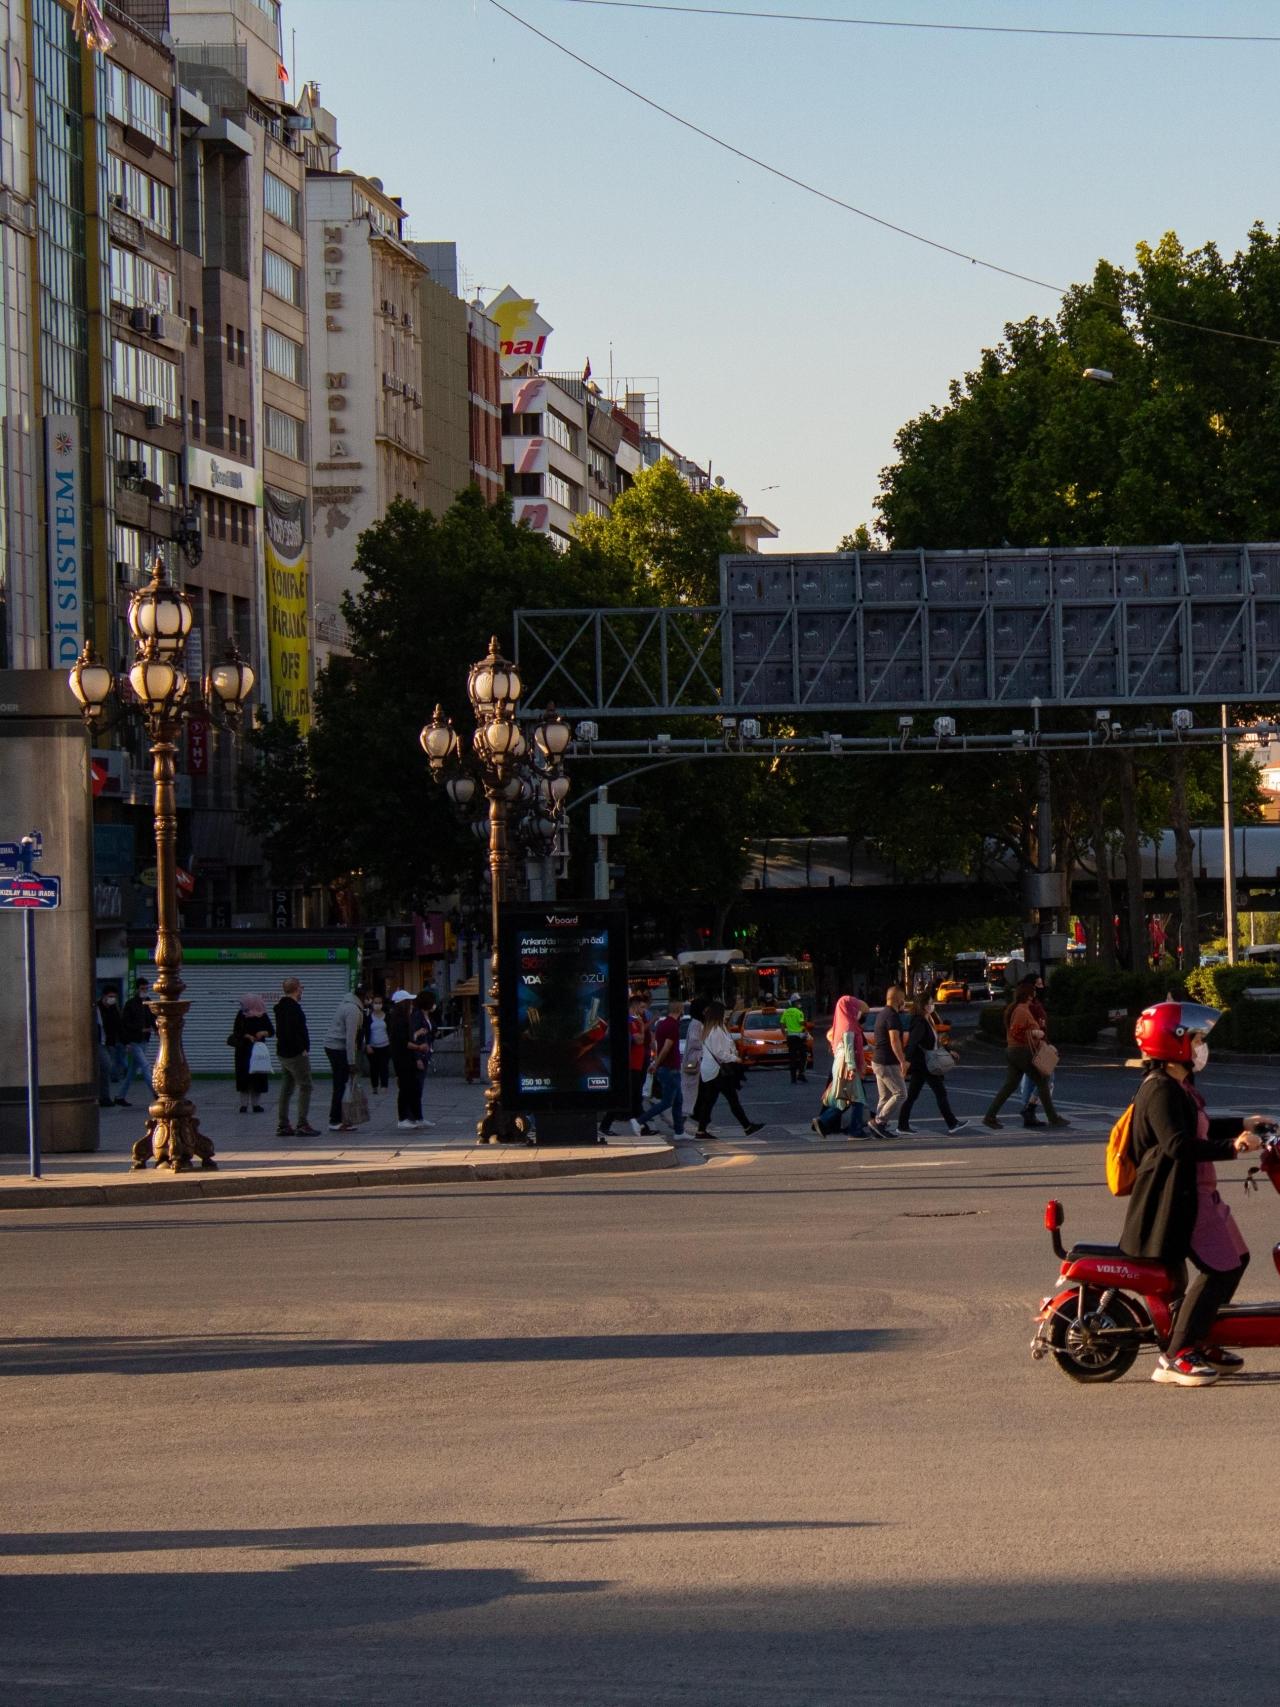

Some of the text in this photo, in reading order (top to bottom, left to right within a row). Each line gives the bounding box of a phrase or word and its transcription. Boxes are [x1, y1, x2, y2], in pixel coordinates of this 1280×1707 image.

[323, 226, 346, 332] HOTEL
[326, 372, 347, 457] MOLA
[53, 468, 78, 611] SİSTEM
[192, 736, 202, 768] THY
[546, 914, 579, 925] Vboard
[521, 936, 557, 946] Ankara'da
[522, 975, 542, 985] YDA
[521, 1078, 534, 1086] 250
[1096, 1264, 1129, 1275] VOLTA
